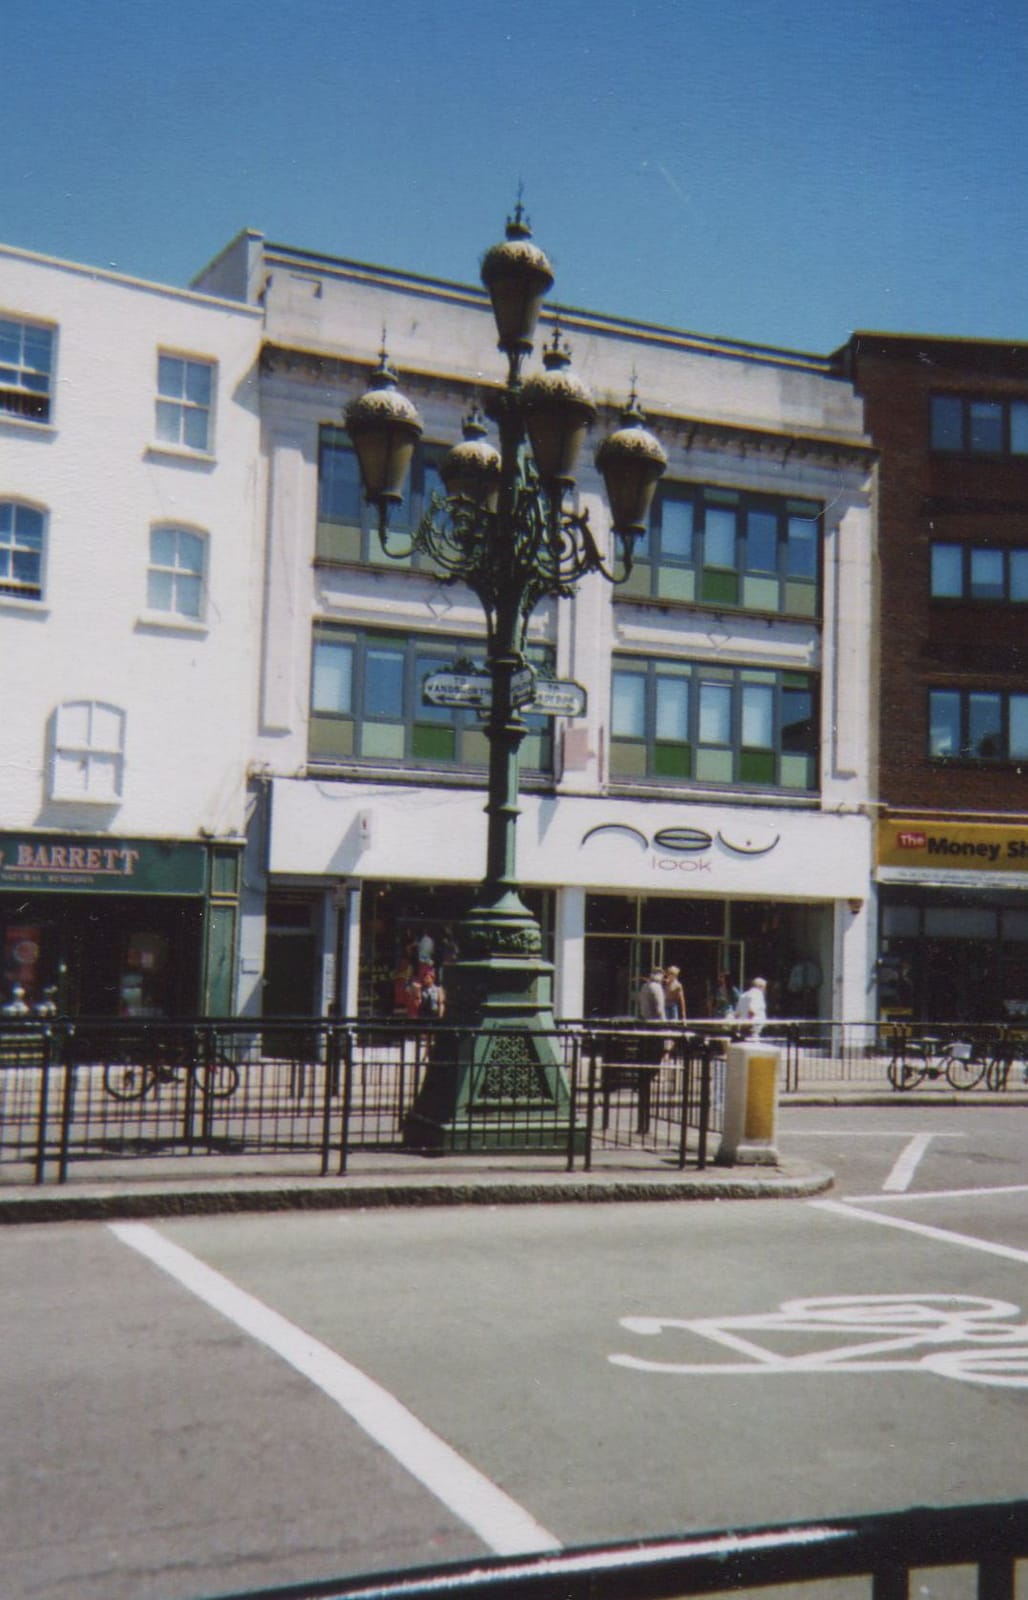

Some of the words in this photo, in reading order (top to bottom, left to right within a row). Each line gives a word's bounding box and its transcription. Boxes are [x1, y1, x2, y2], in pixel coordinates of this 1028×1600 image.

[17, 844, 140, 875] BARRETT
[899, 834, 925, 846] The
[927, 837, 1001, 861] Money
[651, 855, 712, 872] look
